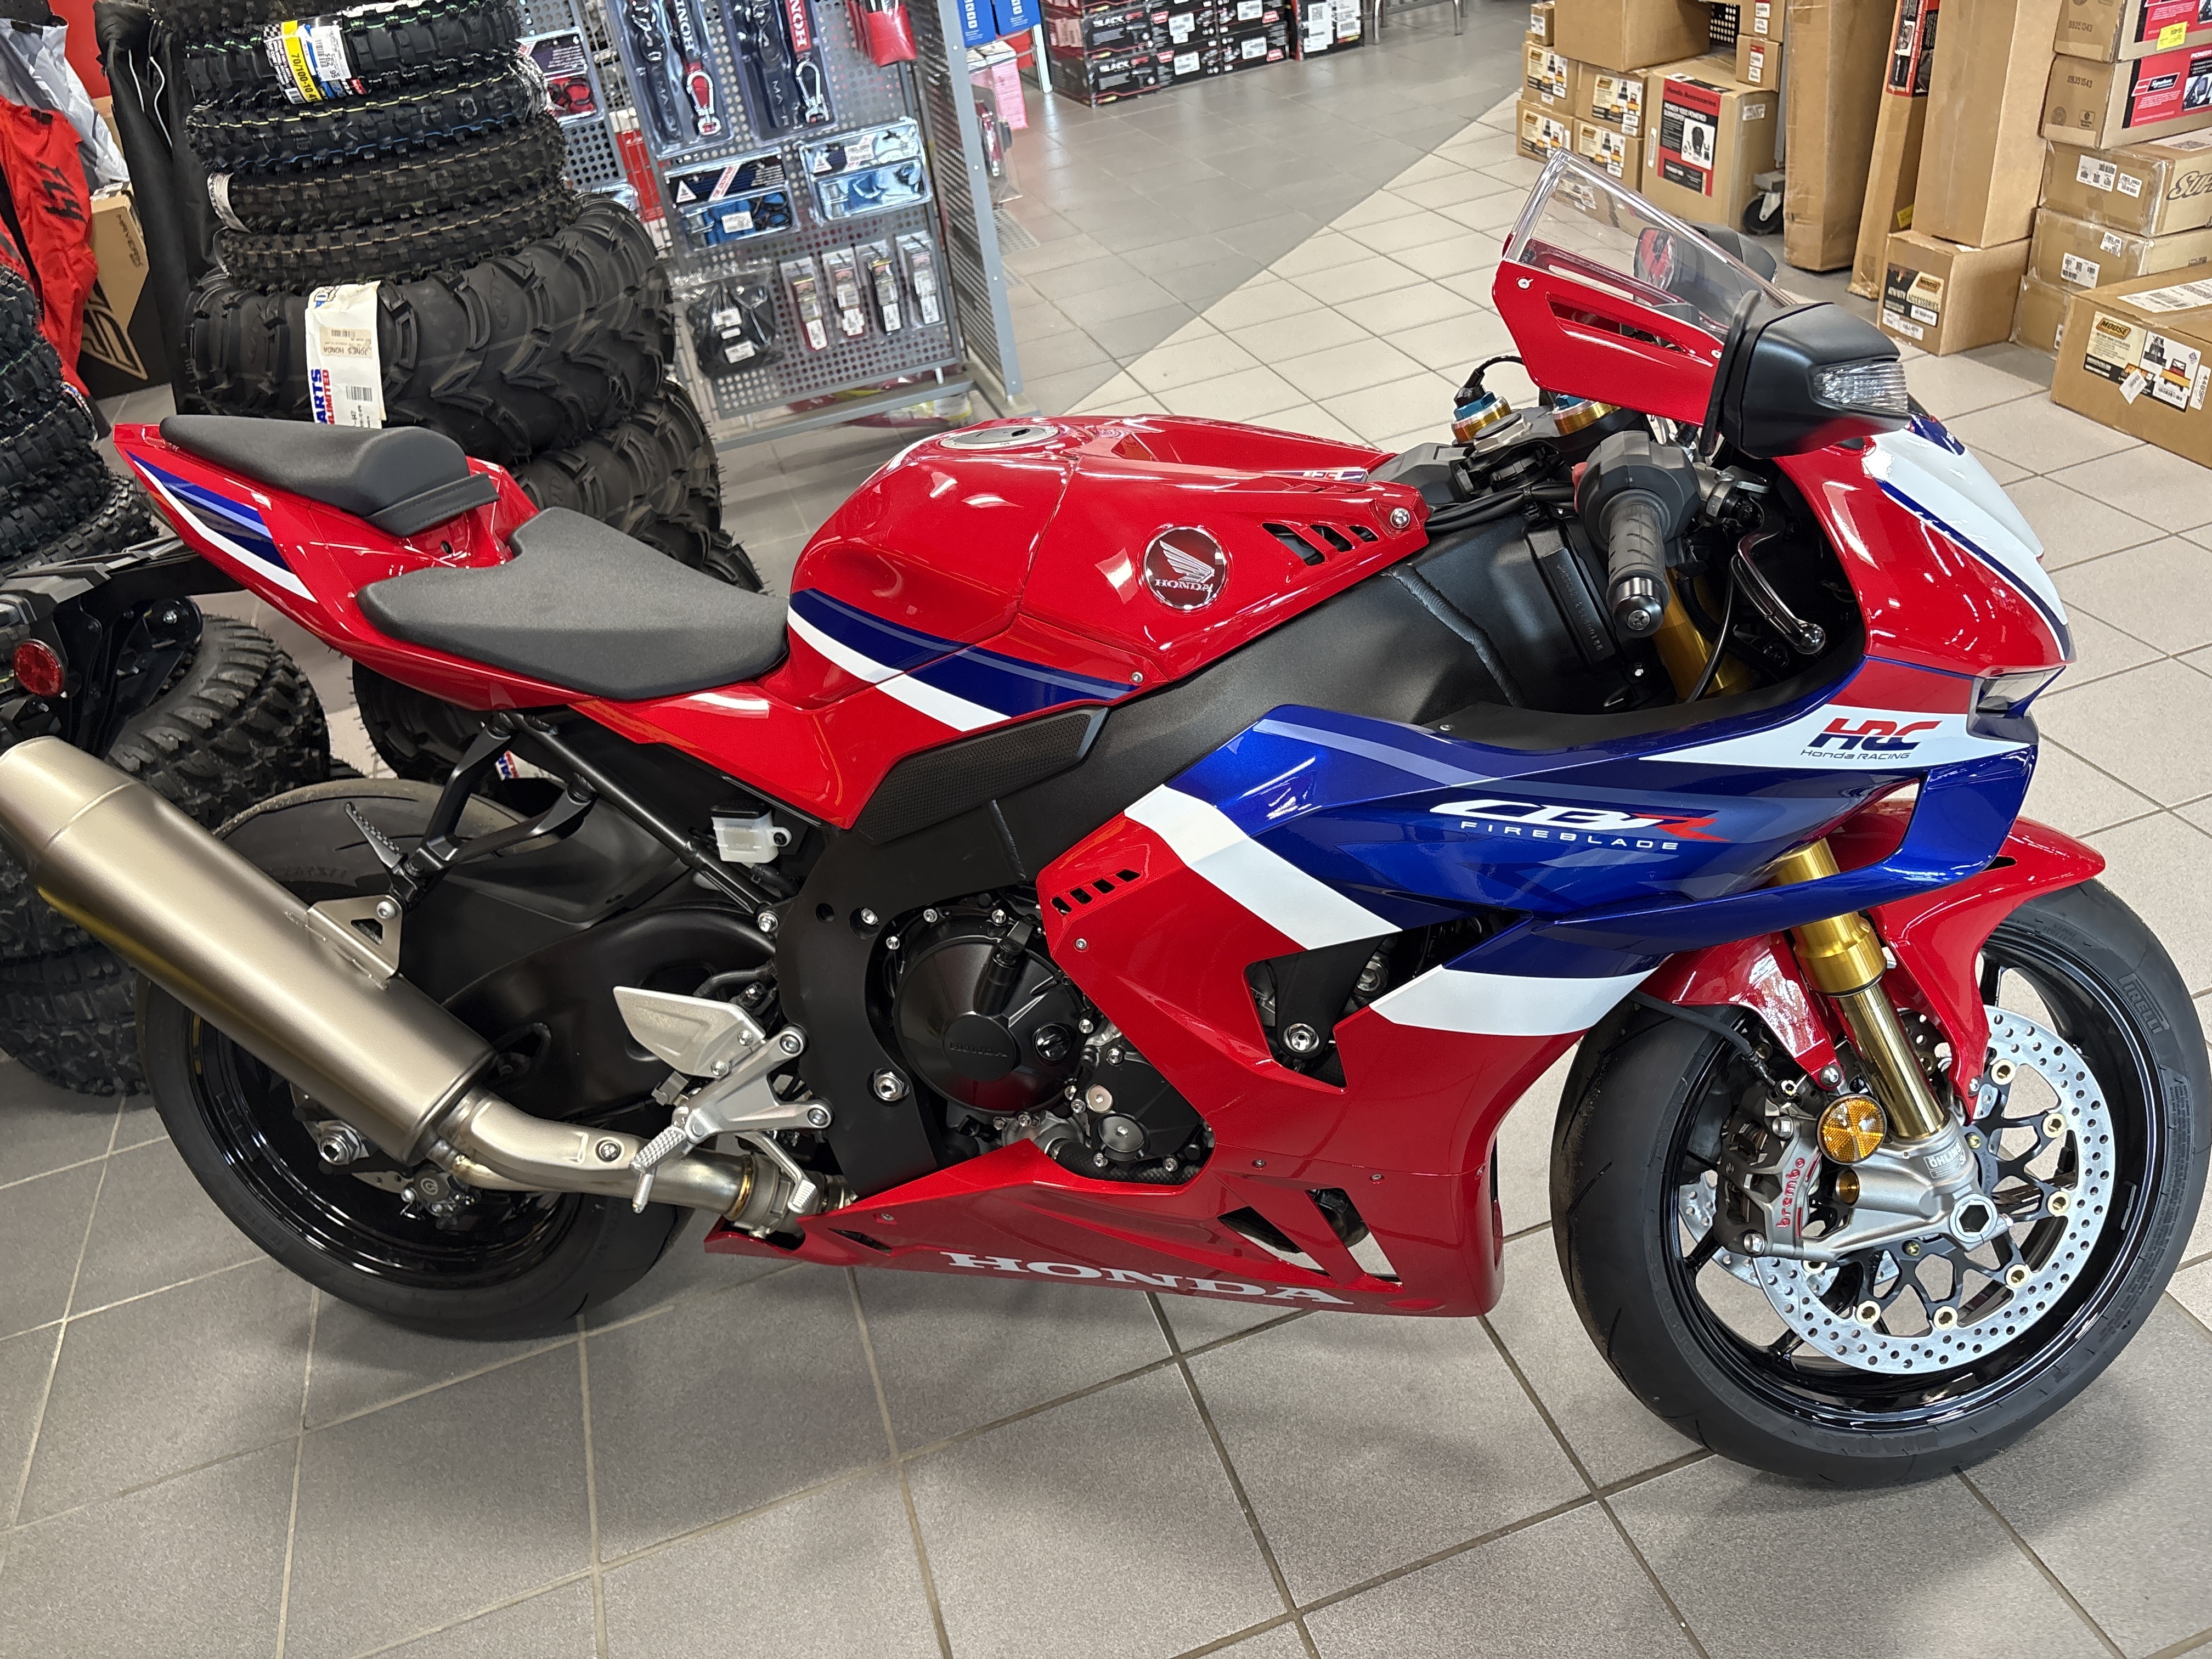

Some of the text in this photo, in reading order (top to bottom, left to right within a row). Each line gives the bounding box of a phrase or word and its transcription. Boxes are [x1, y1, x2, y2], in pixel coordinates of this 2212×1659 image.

[791, 0, 808, 47] HON
[291, 53, 313, 93] 70/100-10
[2102, 320, 2129, 335] MOOSE
[311, 369, 328, 423] ARTS
[1154, 579, 1212, 592] HONDA
[1801, 749, 1855, 759] Honda
[1807, 718, 1943, 751] HRC
[1460, 821, 1679, 850] FIREBLADE
[2117, 972, 2170, 1034] PIRELLI
[1776, 1158, 1805, 1228] brembo
[939, 1251, 1354, 1305] HONDA
